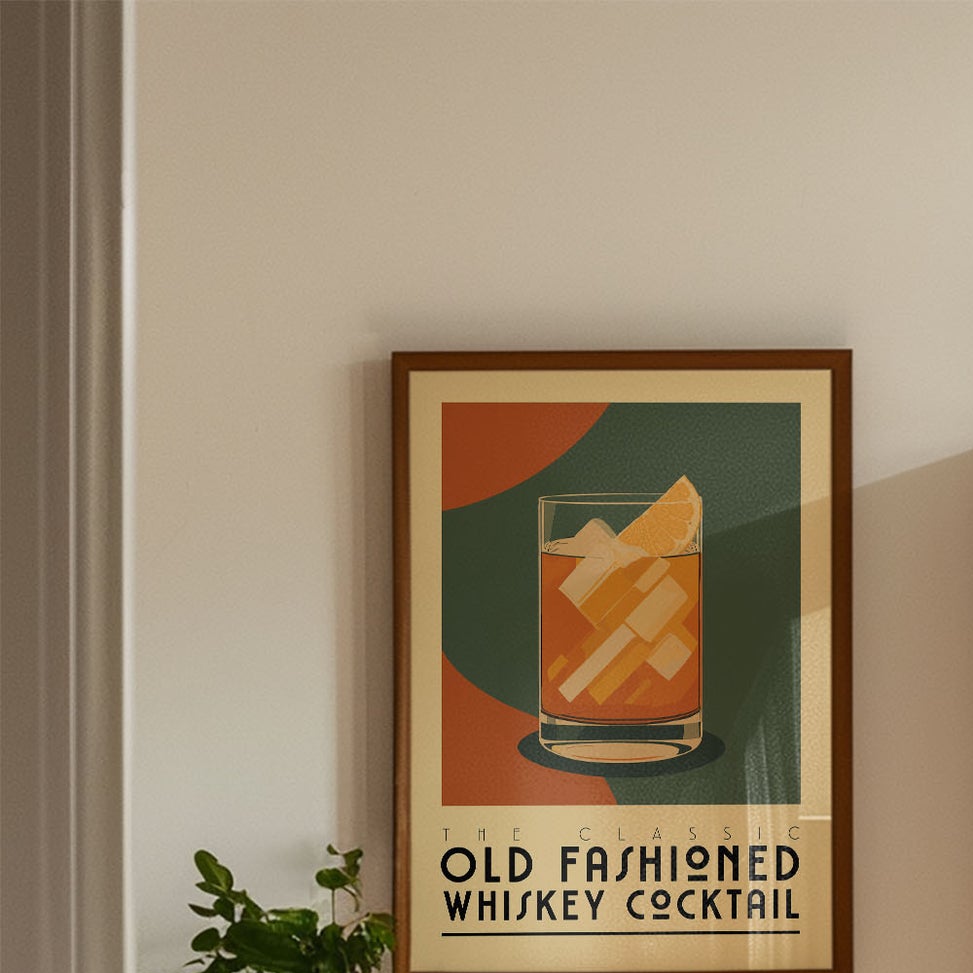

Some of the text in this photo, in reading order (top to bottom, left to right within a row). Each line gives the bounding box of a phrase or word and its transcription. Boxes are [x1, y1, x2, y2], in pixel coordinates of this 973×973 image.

[442, 825, 800, 842] THE CLASSIC
[440, 845, 800, 883] OLD FASHIONED
[443, 889, 800, 922] WHISKEY COCKTAIL
